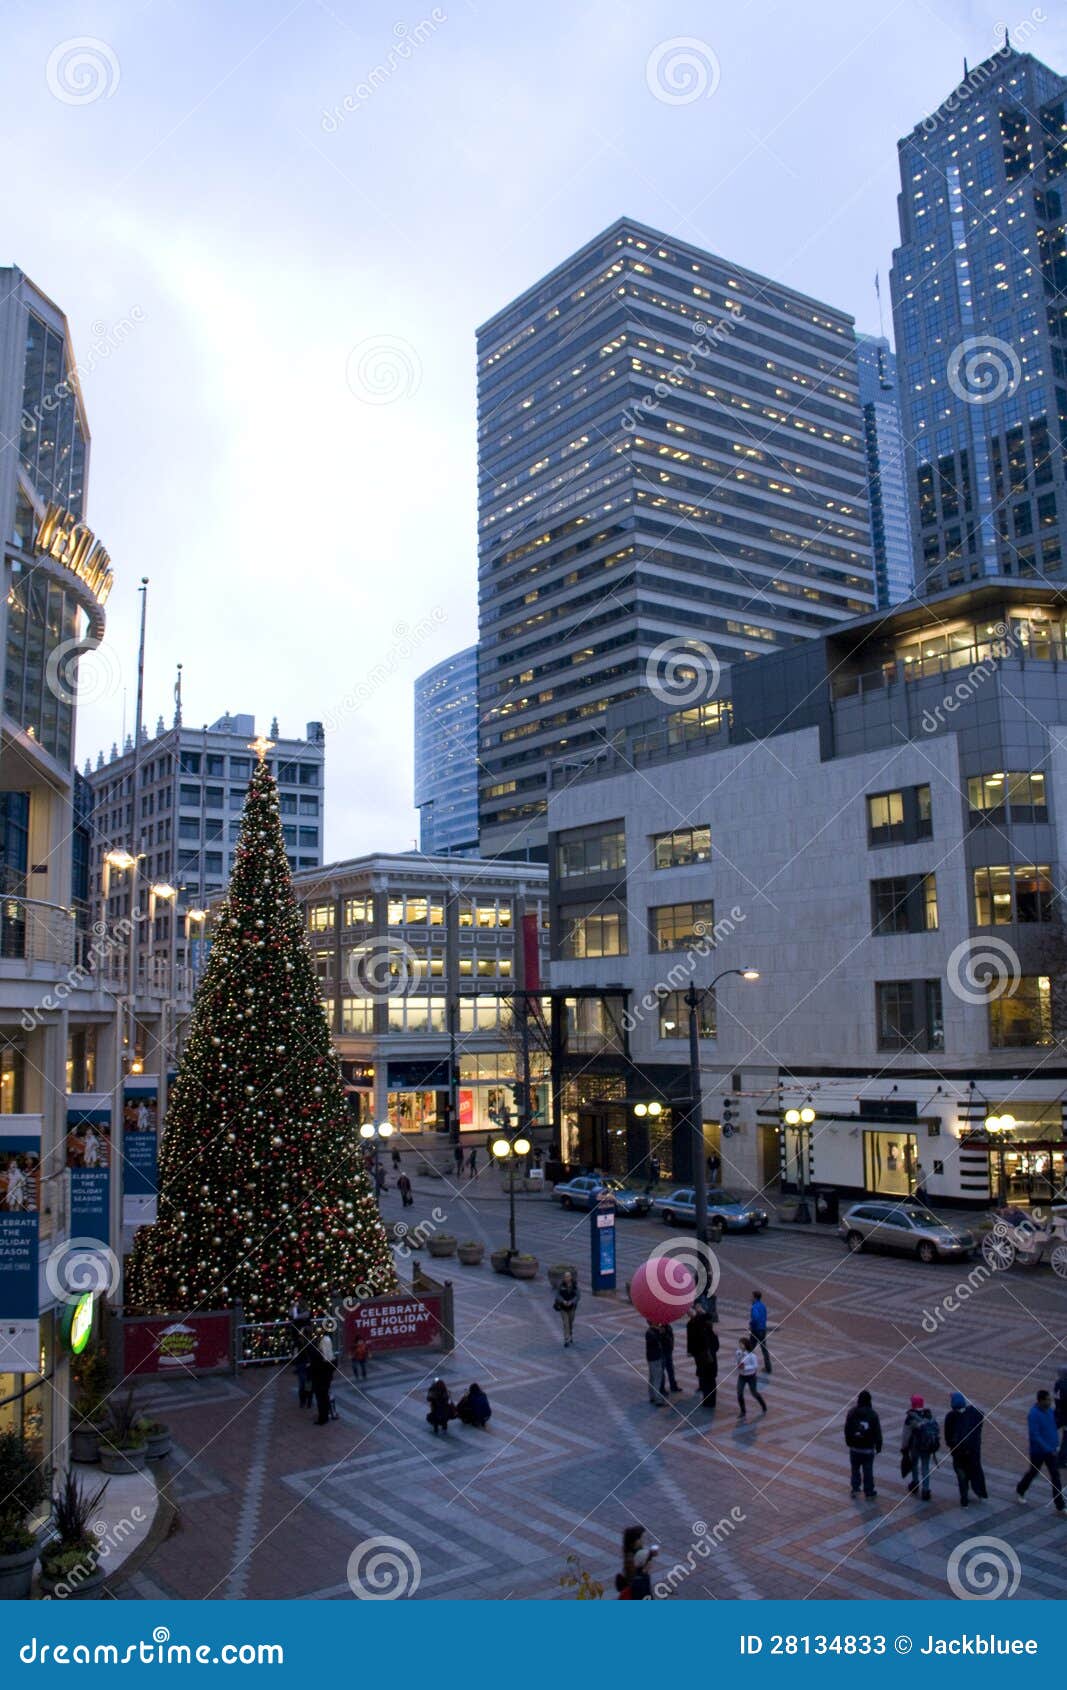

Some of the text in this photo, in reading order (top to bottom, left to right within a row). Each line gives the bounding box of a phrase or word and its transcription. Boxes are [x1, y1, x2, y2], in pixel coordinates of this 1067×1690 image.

[3, 1228, 20, 1236] THE
[0, 1238, 31, 1246] OLIDAY
[0, 1248, 30, 1256] EASON
[360, 1303, 426, 1318] CELEBRATE
[354, 1312, 431, 1328] THE HOLIDAY
[370, 1323, 417, 1337] SEASON
